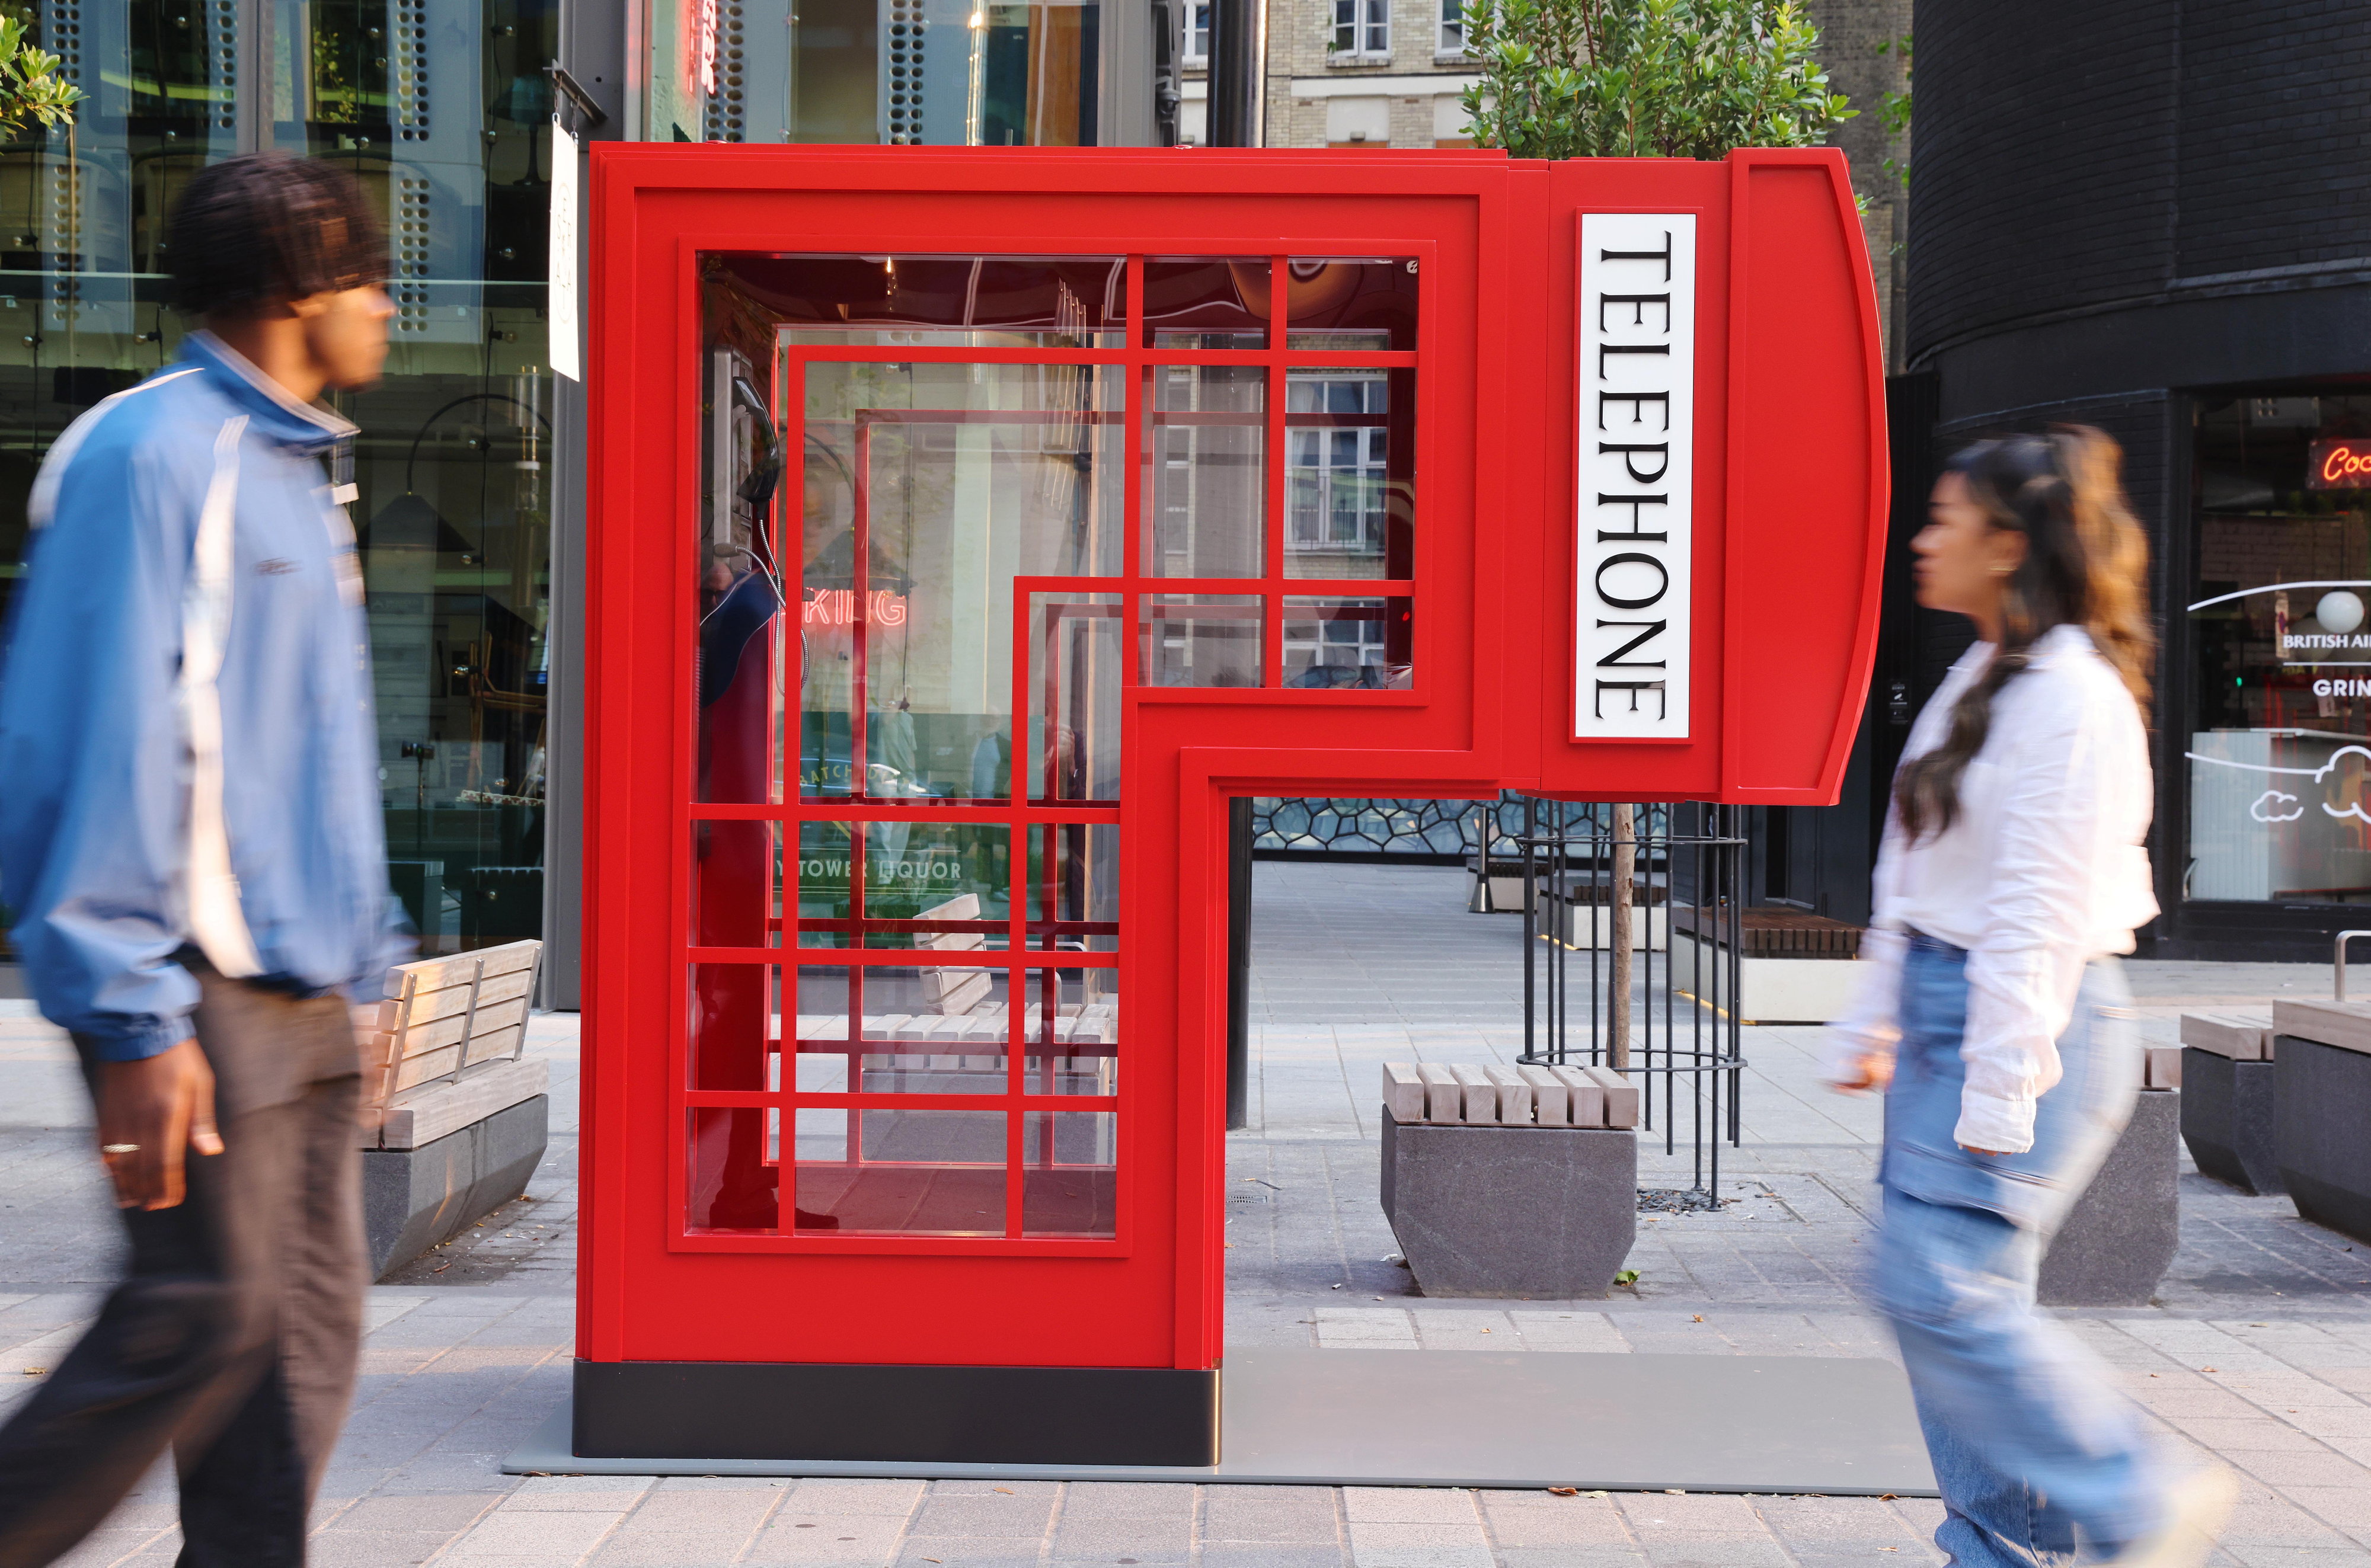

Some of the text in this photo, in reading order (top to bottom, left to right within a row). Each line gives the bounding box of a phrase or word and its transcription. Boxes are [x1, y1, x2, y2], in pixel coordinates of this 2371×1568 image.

[1594, 230, 1672, 722] TELEPHONE
[2283, 634, 2349, 648] BRITISH
[878, 861, 961, 879] LIQUOR
